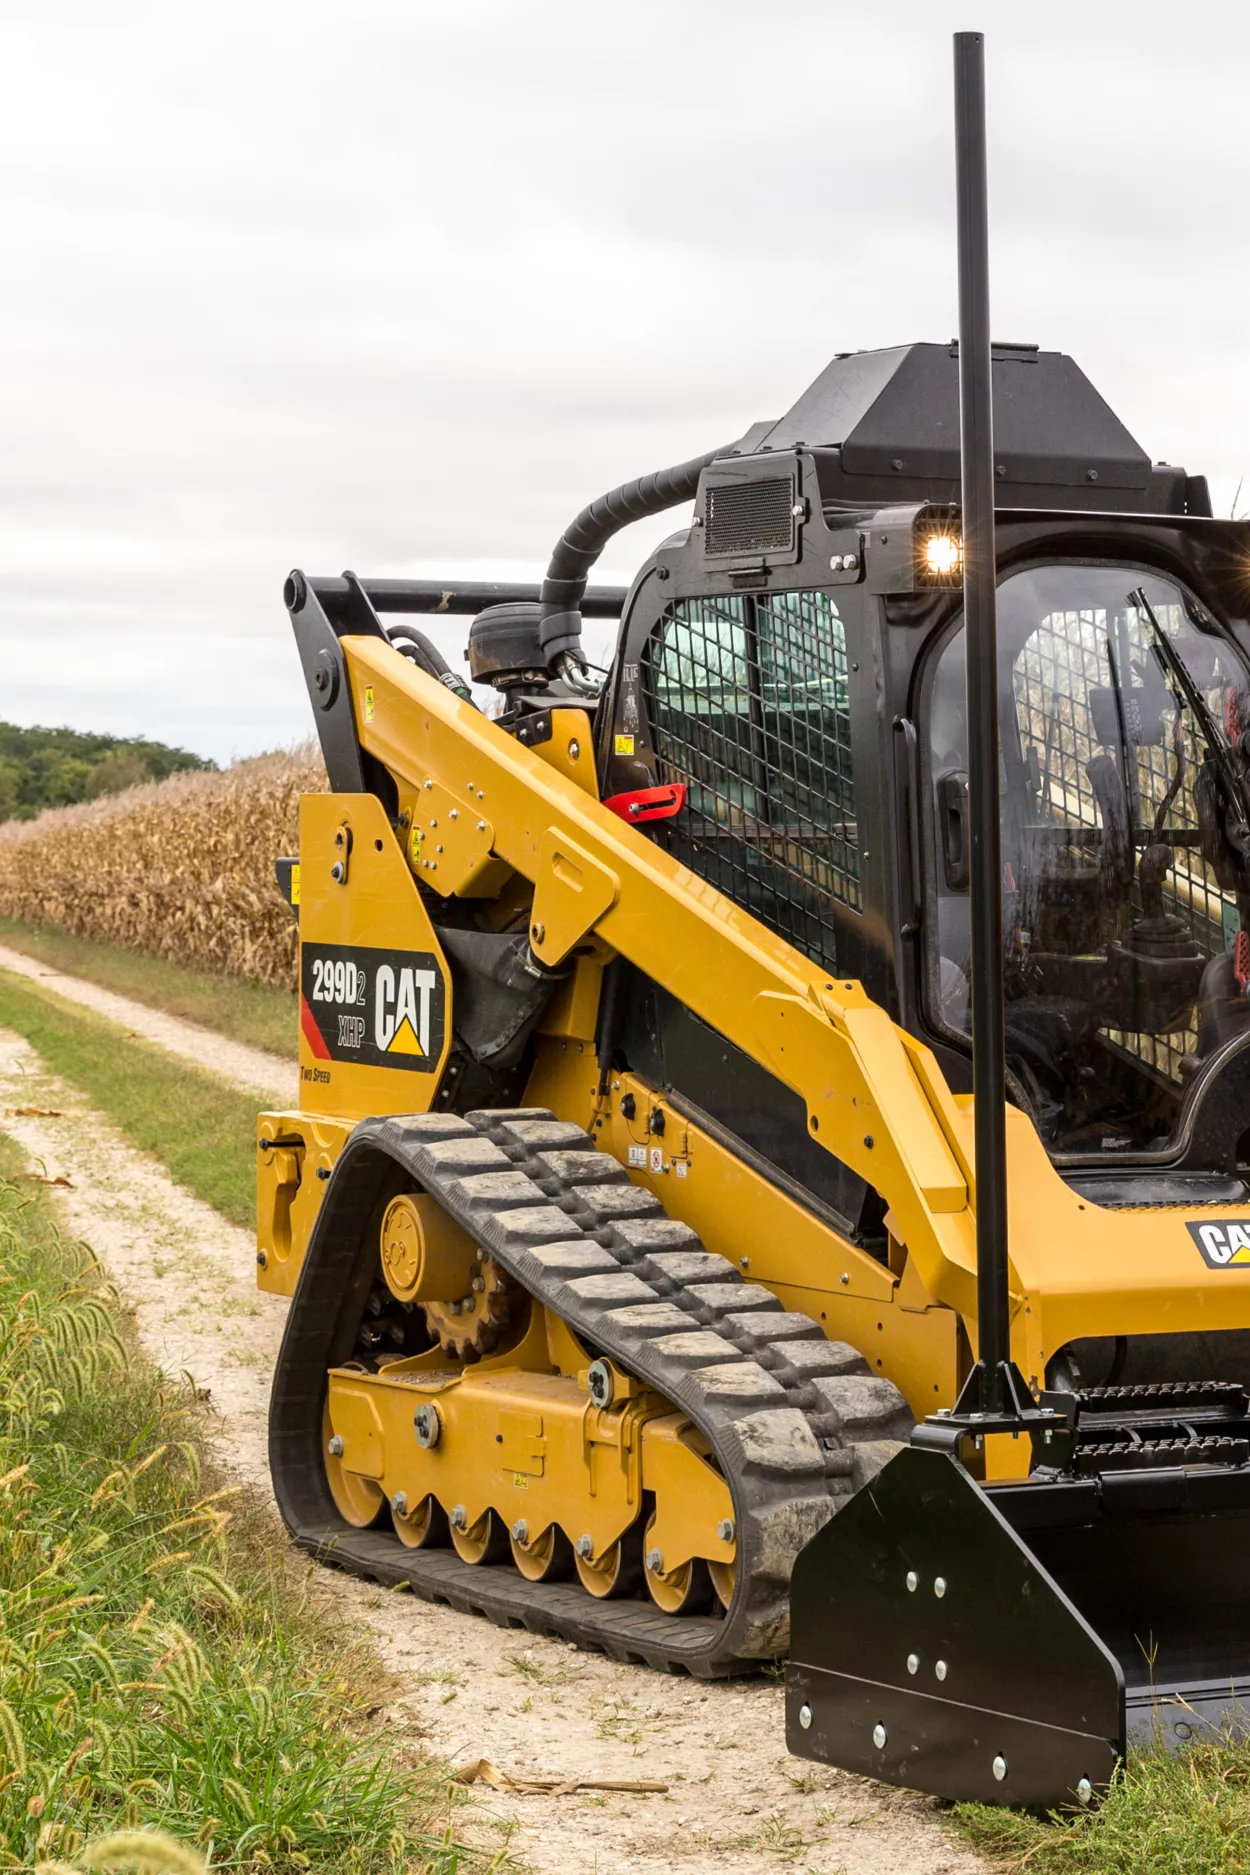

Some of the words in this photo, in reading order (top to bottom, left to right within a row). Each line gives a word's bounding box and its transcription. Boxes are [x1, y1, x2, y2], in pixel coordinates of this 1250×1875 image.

[312, 959, 366, 1006] 299D2
[338, 1015, 366, 1048] XHP
[375, 965, 436, 1057] CAT
